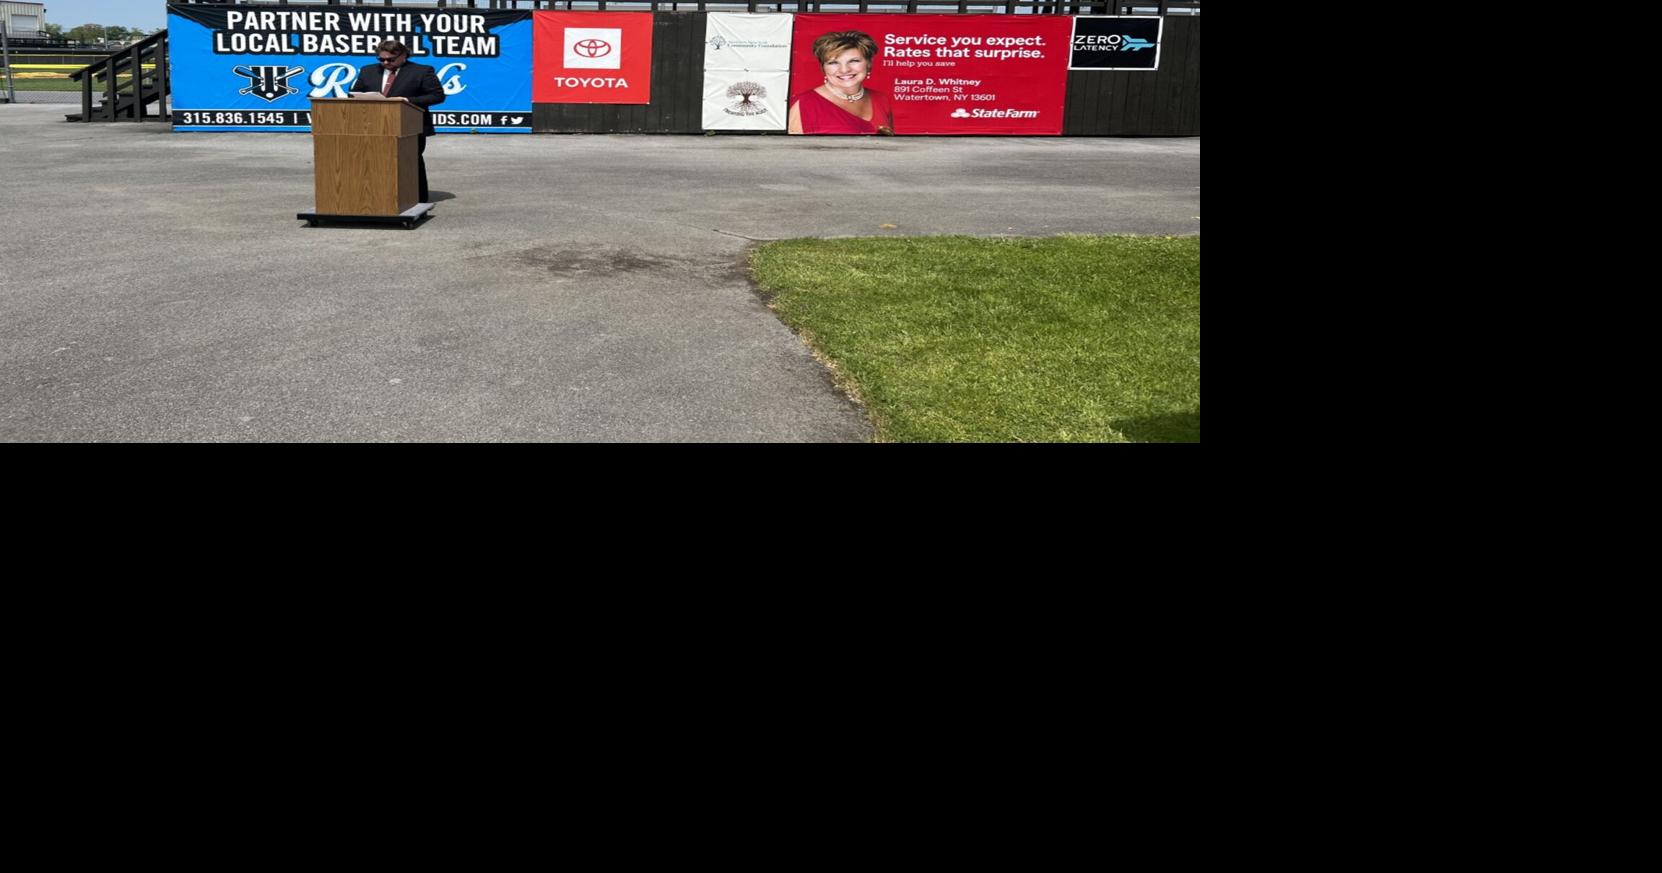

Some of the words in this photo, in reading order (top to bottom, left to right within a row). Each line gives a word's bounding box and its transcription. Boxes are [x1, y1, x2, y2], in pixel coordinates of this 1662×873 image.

[227, 11, 340, 31] PARTNER
[348, 12, 412, 32] WITH
[420, 14, 486, 33] YOUR
[216, 33, 294, 52] LOCAL
[303, 34, 426, 54] BASEBL
[433, 35, 496, 55] TEAM
[884, 33, 947, 45] Service
[951, 36, 982, 47] you
[986, 35, 1046, 48] expect.
[1074, 34, 1121, 45] ZERO
[884, 46, 931, 57] Rates
[936, 47, 970, 58] that
[974, 47, 1045, 60] surprise.
[896, 60, 915, 68] help
[554, 77, 629, 88] TOYOTA
[940, 78, 981, 87] Whitney
[183, 112, 284, 124] 315.836.1545
